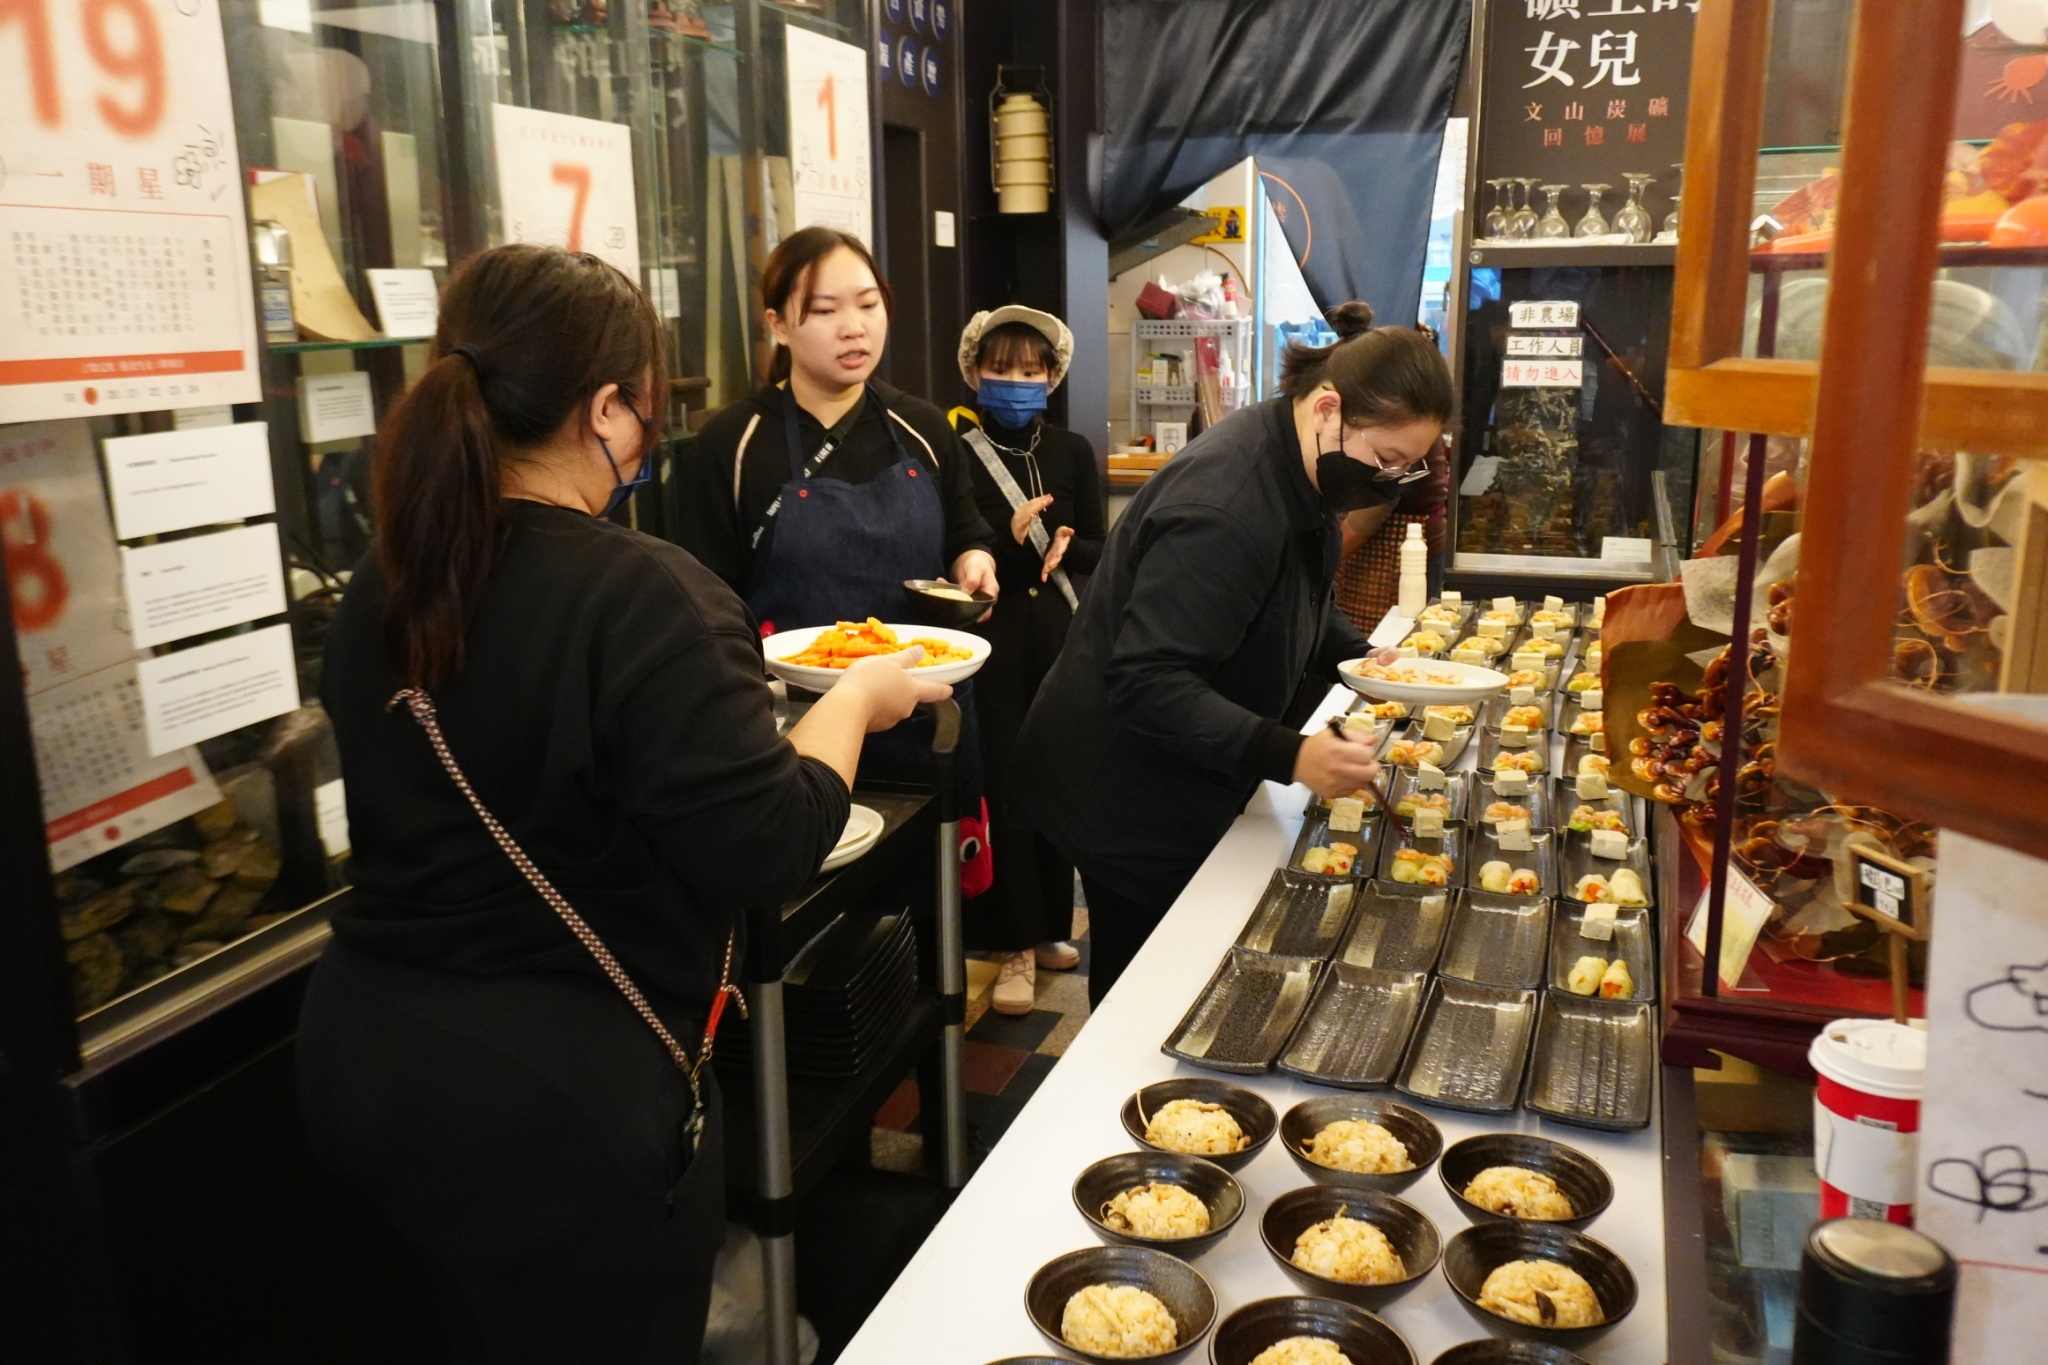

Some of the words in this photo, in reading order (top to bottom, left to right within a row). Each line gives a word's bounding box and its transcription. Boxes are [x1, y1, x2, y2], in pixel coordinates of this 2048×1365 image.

[0, 0, 166, 138] 19
[1522, 29, 1641, 89] 女兒
[818, 73, 838, 161] 1
[1524, 97, 1669, 122] 文山炭礦
[1543, 123, 1647, 147] 回憶展
[549, 161, 592, 254] 7
[1520, 306, 1576, 323] 非農場
[1508, 338, 1580, 356] 工作人員
[1506, 365, 1580, 381] 請勿進入
